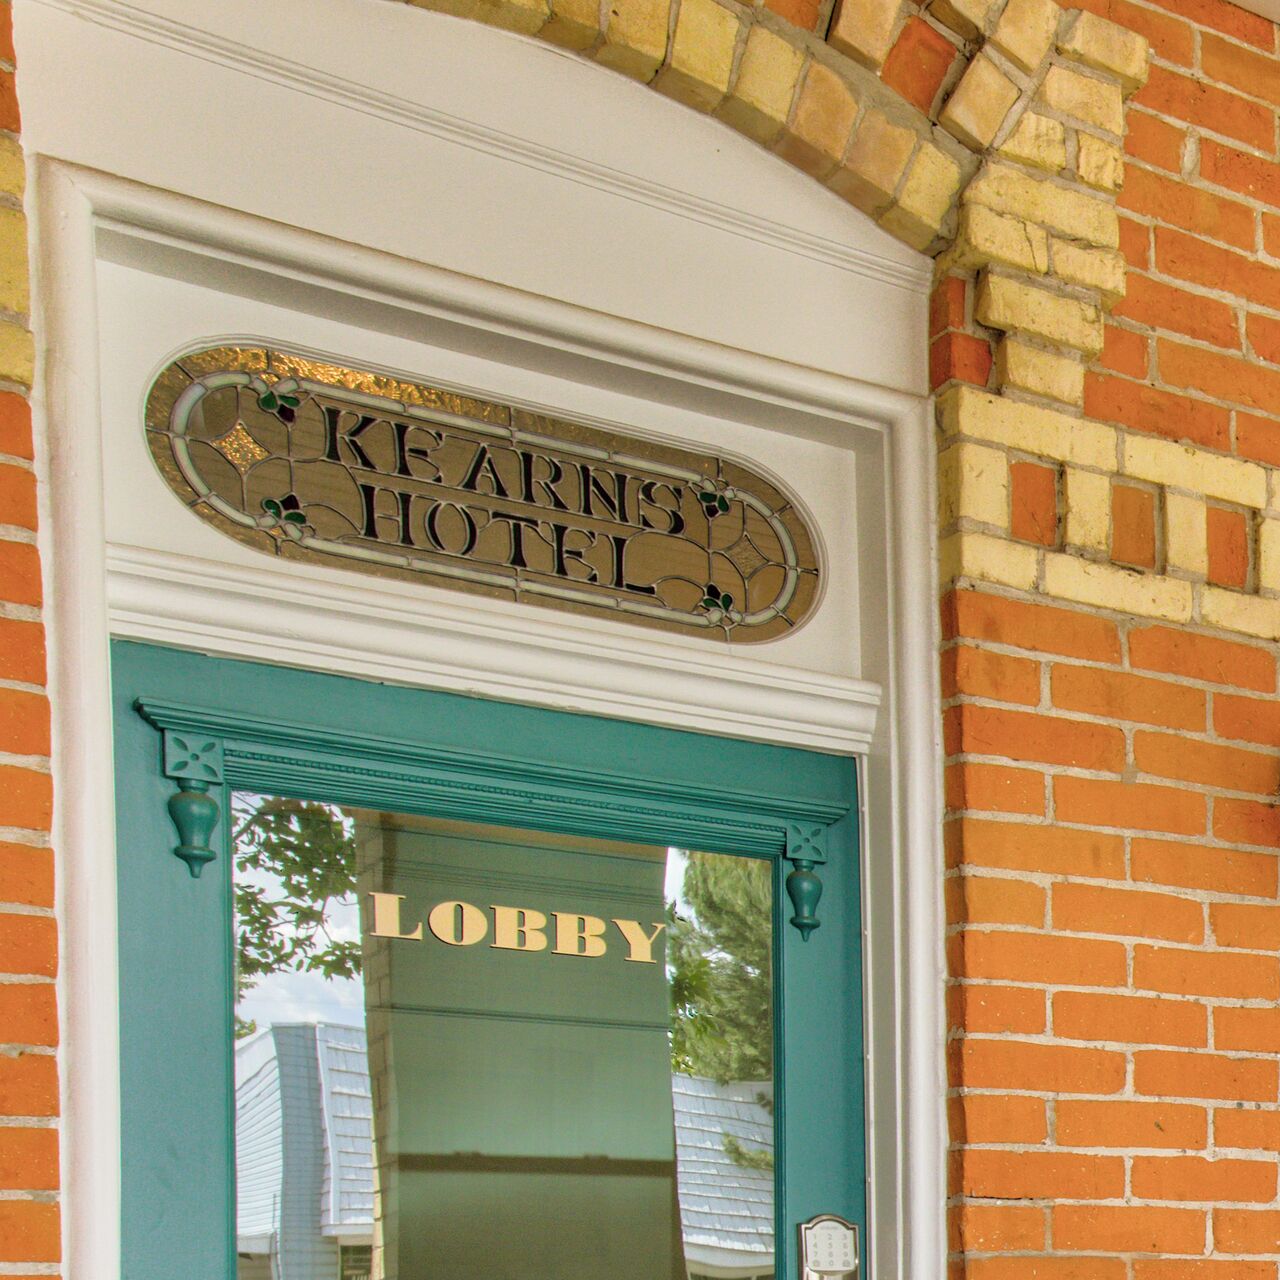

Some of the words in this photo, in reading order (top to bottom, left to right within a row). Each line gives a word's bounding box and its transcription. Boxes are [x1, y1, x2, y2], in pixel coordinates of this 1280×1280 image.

[323, 405, 686, 536] KEARNS
[357, 482, 658, 597] HOTEL
[367, 891, 667, 965] LOBBY
